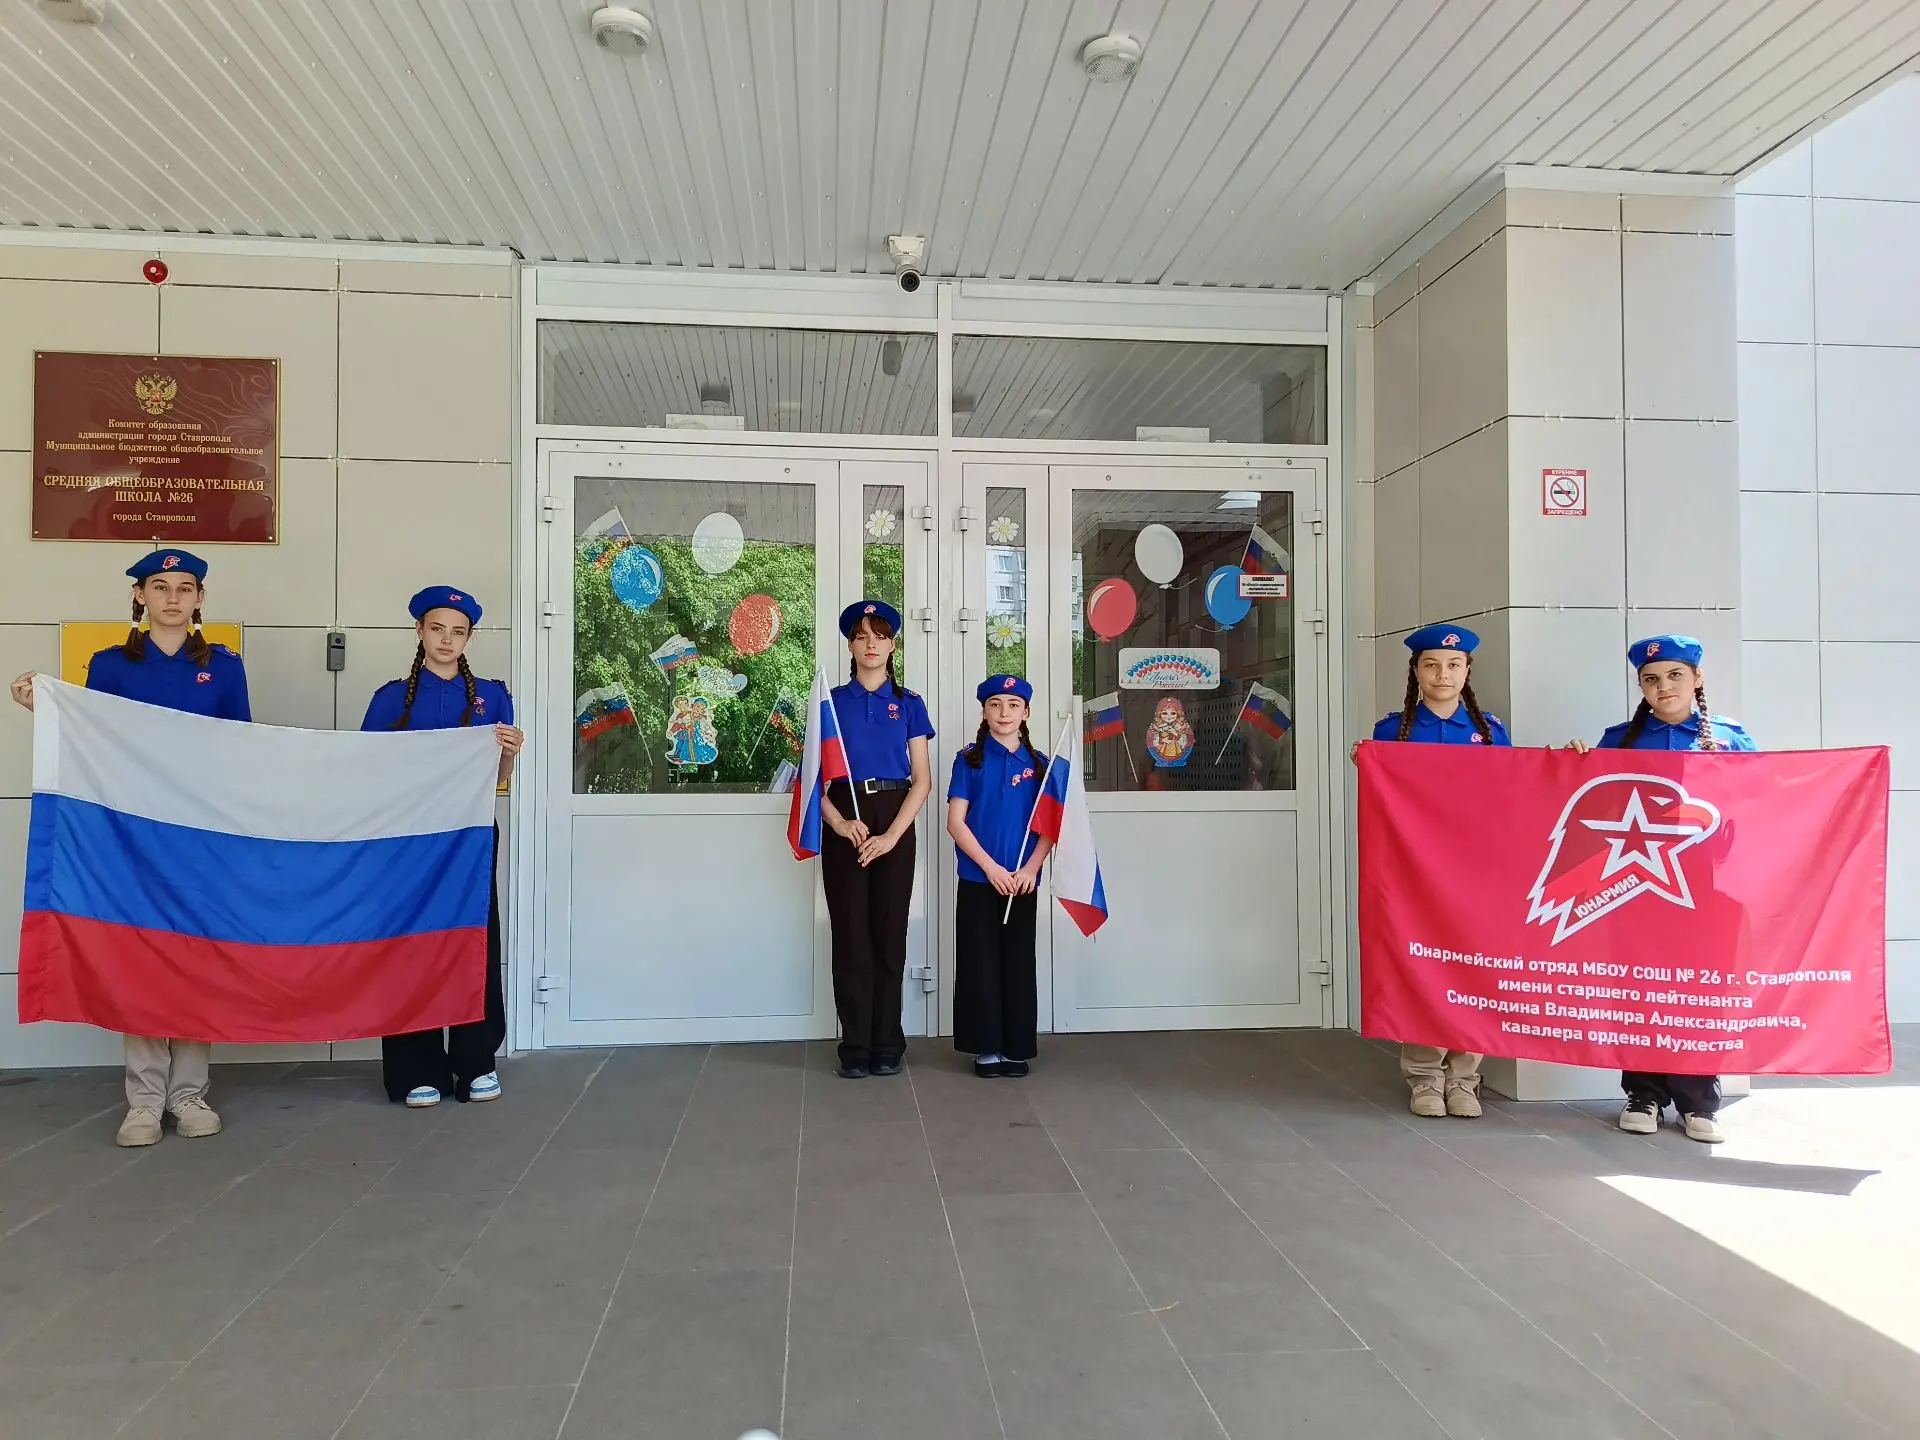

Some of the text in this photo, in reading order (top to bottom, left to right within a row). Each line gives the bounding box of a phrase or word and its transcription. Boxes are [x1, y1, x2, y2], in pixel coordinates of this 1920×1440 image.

[108, 418, 202, 431] Комитет образования
[78, 431, 231, 443] администрации города Ставрополя
[46, 441, 264, 455] Муниципальное бюджетное общеобразовательное
[128, 455, 180, 465] учреждение
[43, 475, 265, 491] СРЕДНЯЯ ОБЩЕОБРАЗОВАТЕЛЬНАЯ
[115, 491, 193, 504] ШКОЛА №26
[112, 512, 196, 523] города Ставрополя
[1573, 873, 1641, 919] ЮНАРМИЯ
[1409, 941, 1852, 988] Юнармейский отряд МБОУ СОШ № 26 г. Ставрополя
[1497, 977, 1753, 1009] имени старшего лейтенанта
[1446, 989, 1807, 1033] Смородина Владимира Александровича,
[1501, 1020, 1744, 1053] кавалера ордена Мужества
